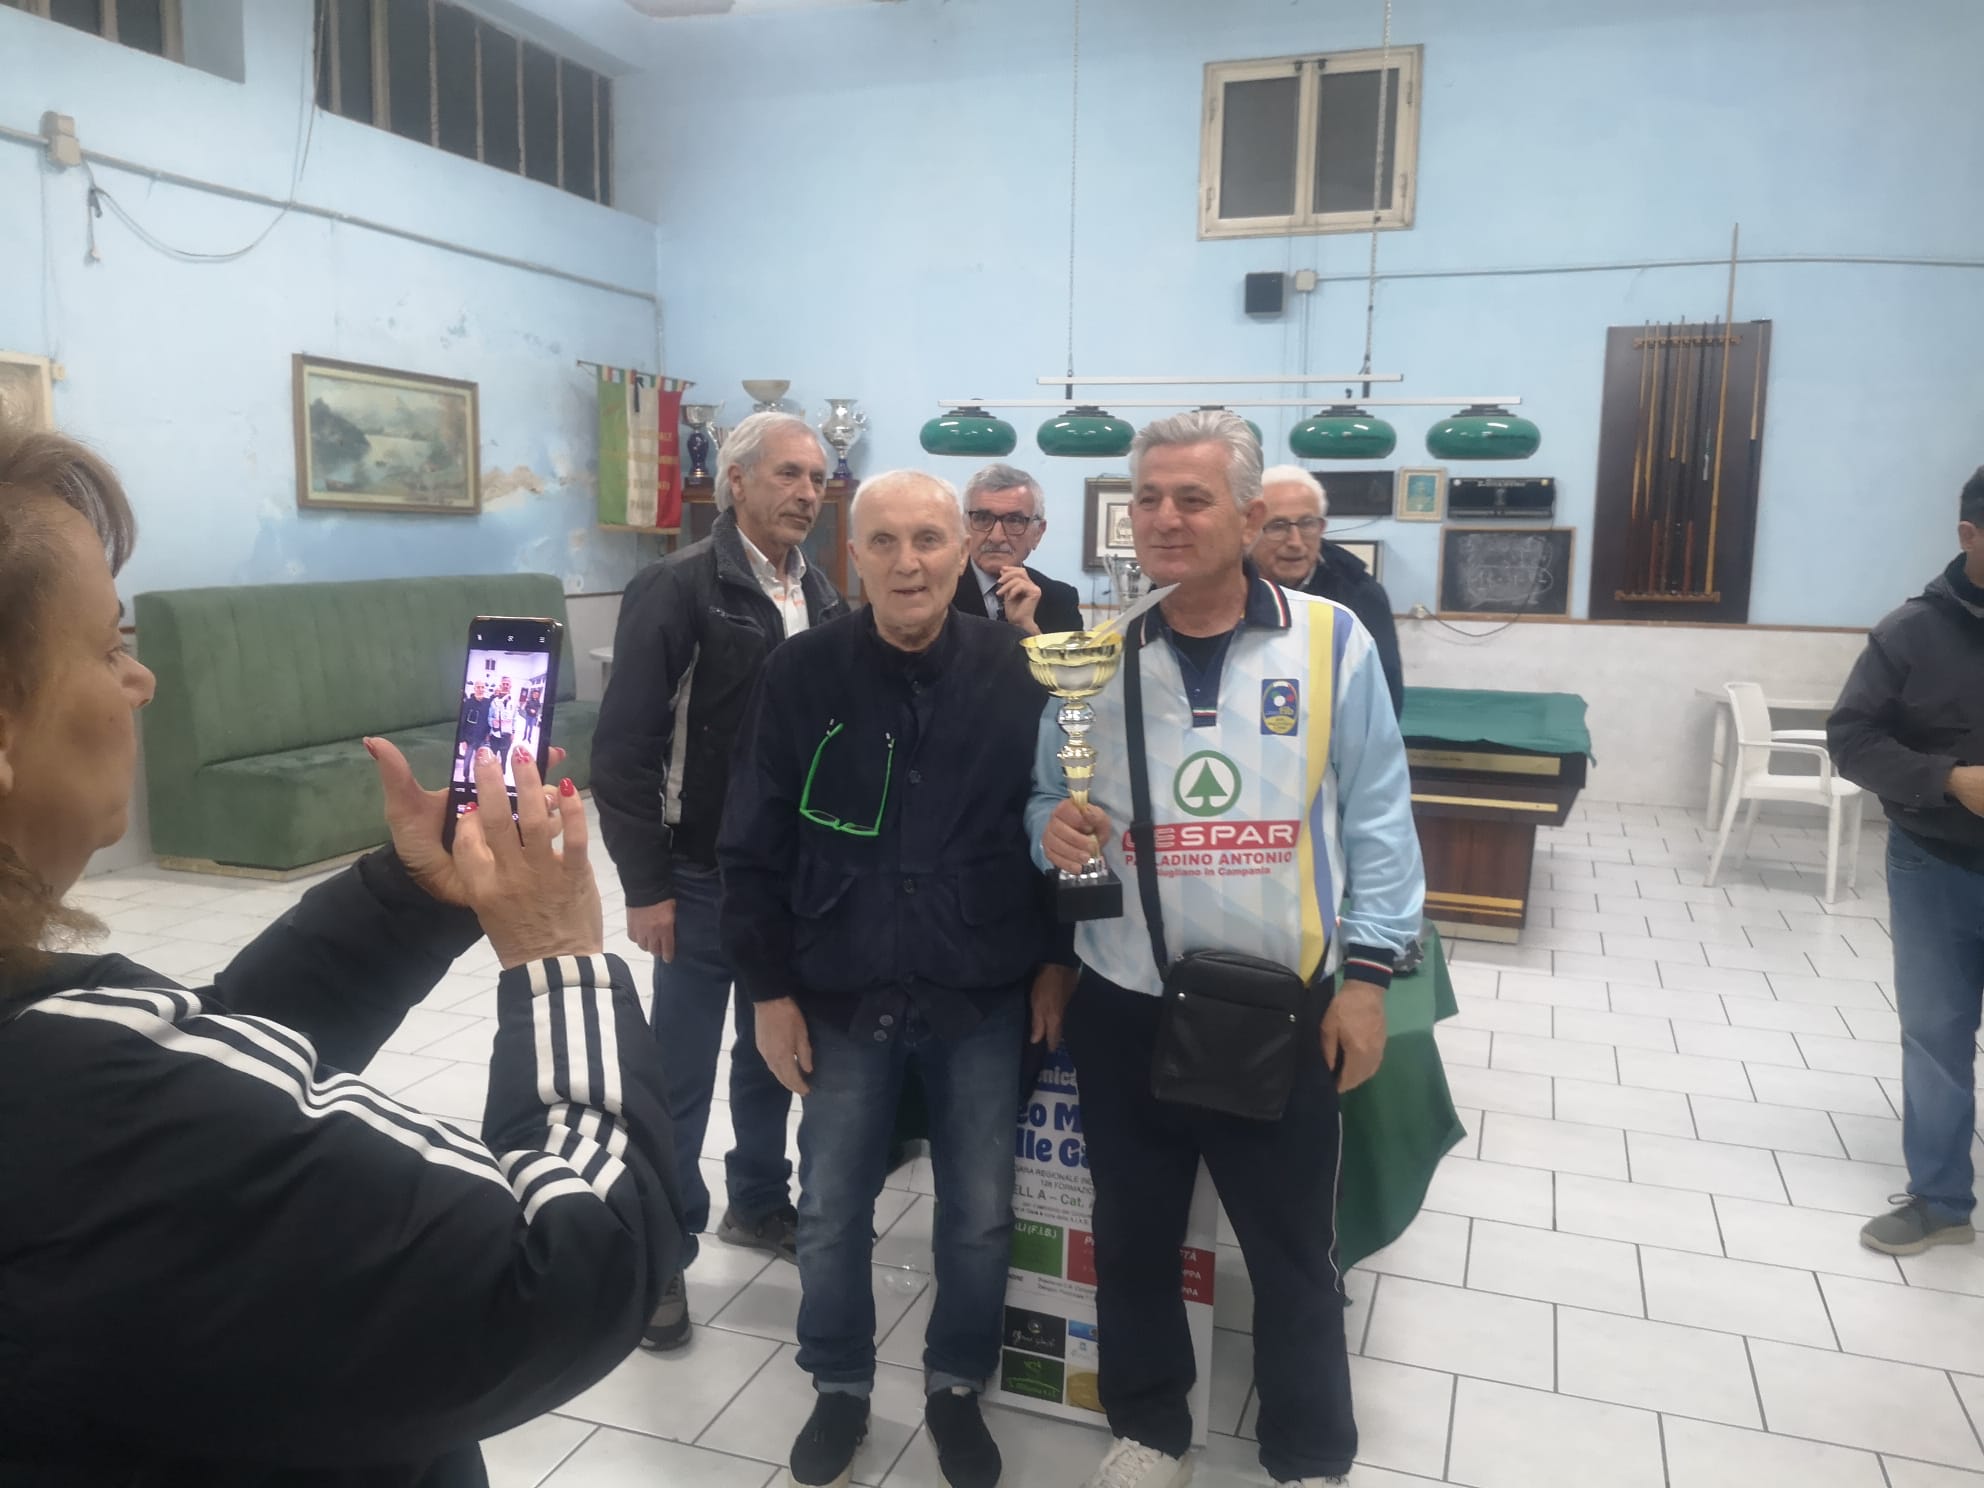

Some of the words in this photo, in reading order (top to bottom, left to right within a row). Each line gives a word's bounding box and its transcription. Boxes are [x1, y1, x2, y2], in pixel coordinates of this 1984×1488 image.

[1125, 854, 1213, 866] PADINO
[1219, 851, 1292, 866] ANTONIO
[1155, 868, 1201, 878] iugliano
[1218, 867, 1271, 876] Campania
[1038, 1189, 1047, 1201] A
